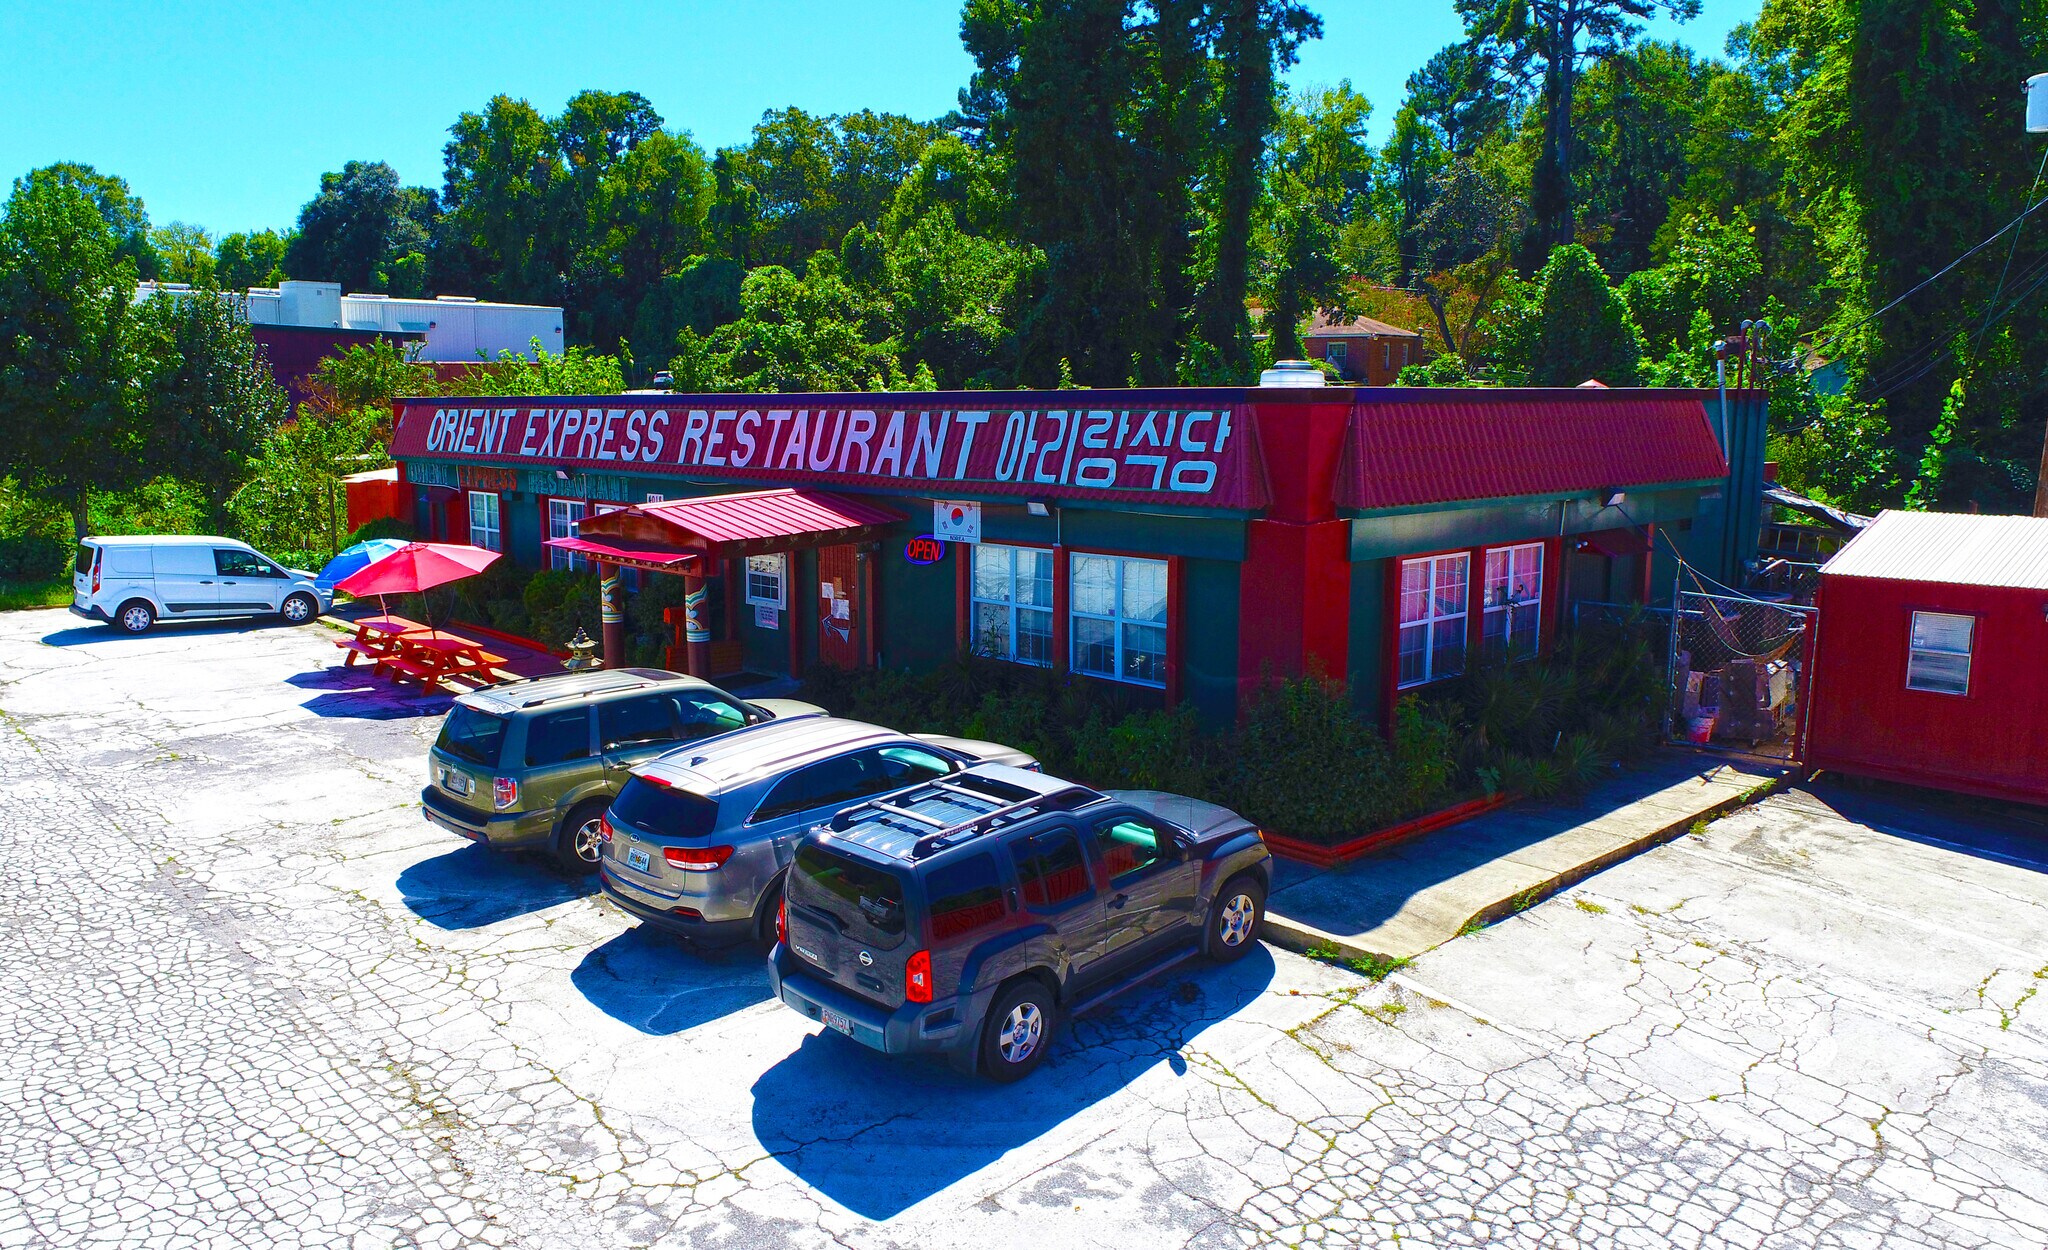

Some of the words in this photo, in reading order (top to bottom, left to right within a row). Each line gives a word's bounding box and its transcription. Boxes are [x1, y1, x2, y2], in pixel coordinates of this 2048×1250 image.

[426, 408, 517, 454] ORIENT
[520, 408, 669, 462] EXPRESS
[677, 409, 990, 480] RESTAURANT
[460, 464, 517, 491] EXPRESS
[907, 538, 940, 561] OPEN
